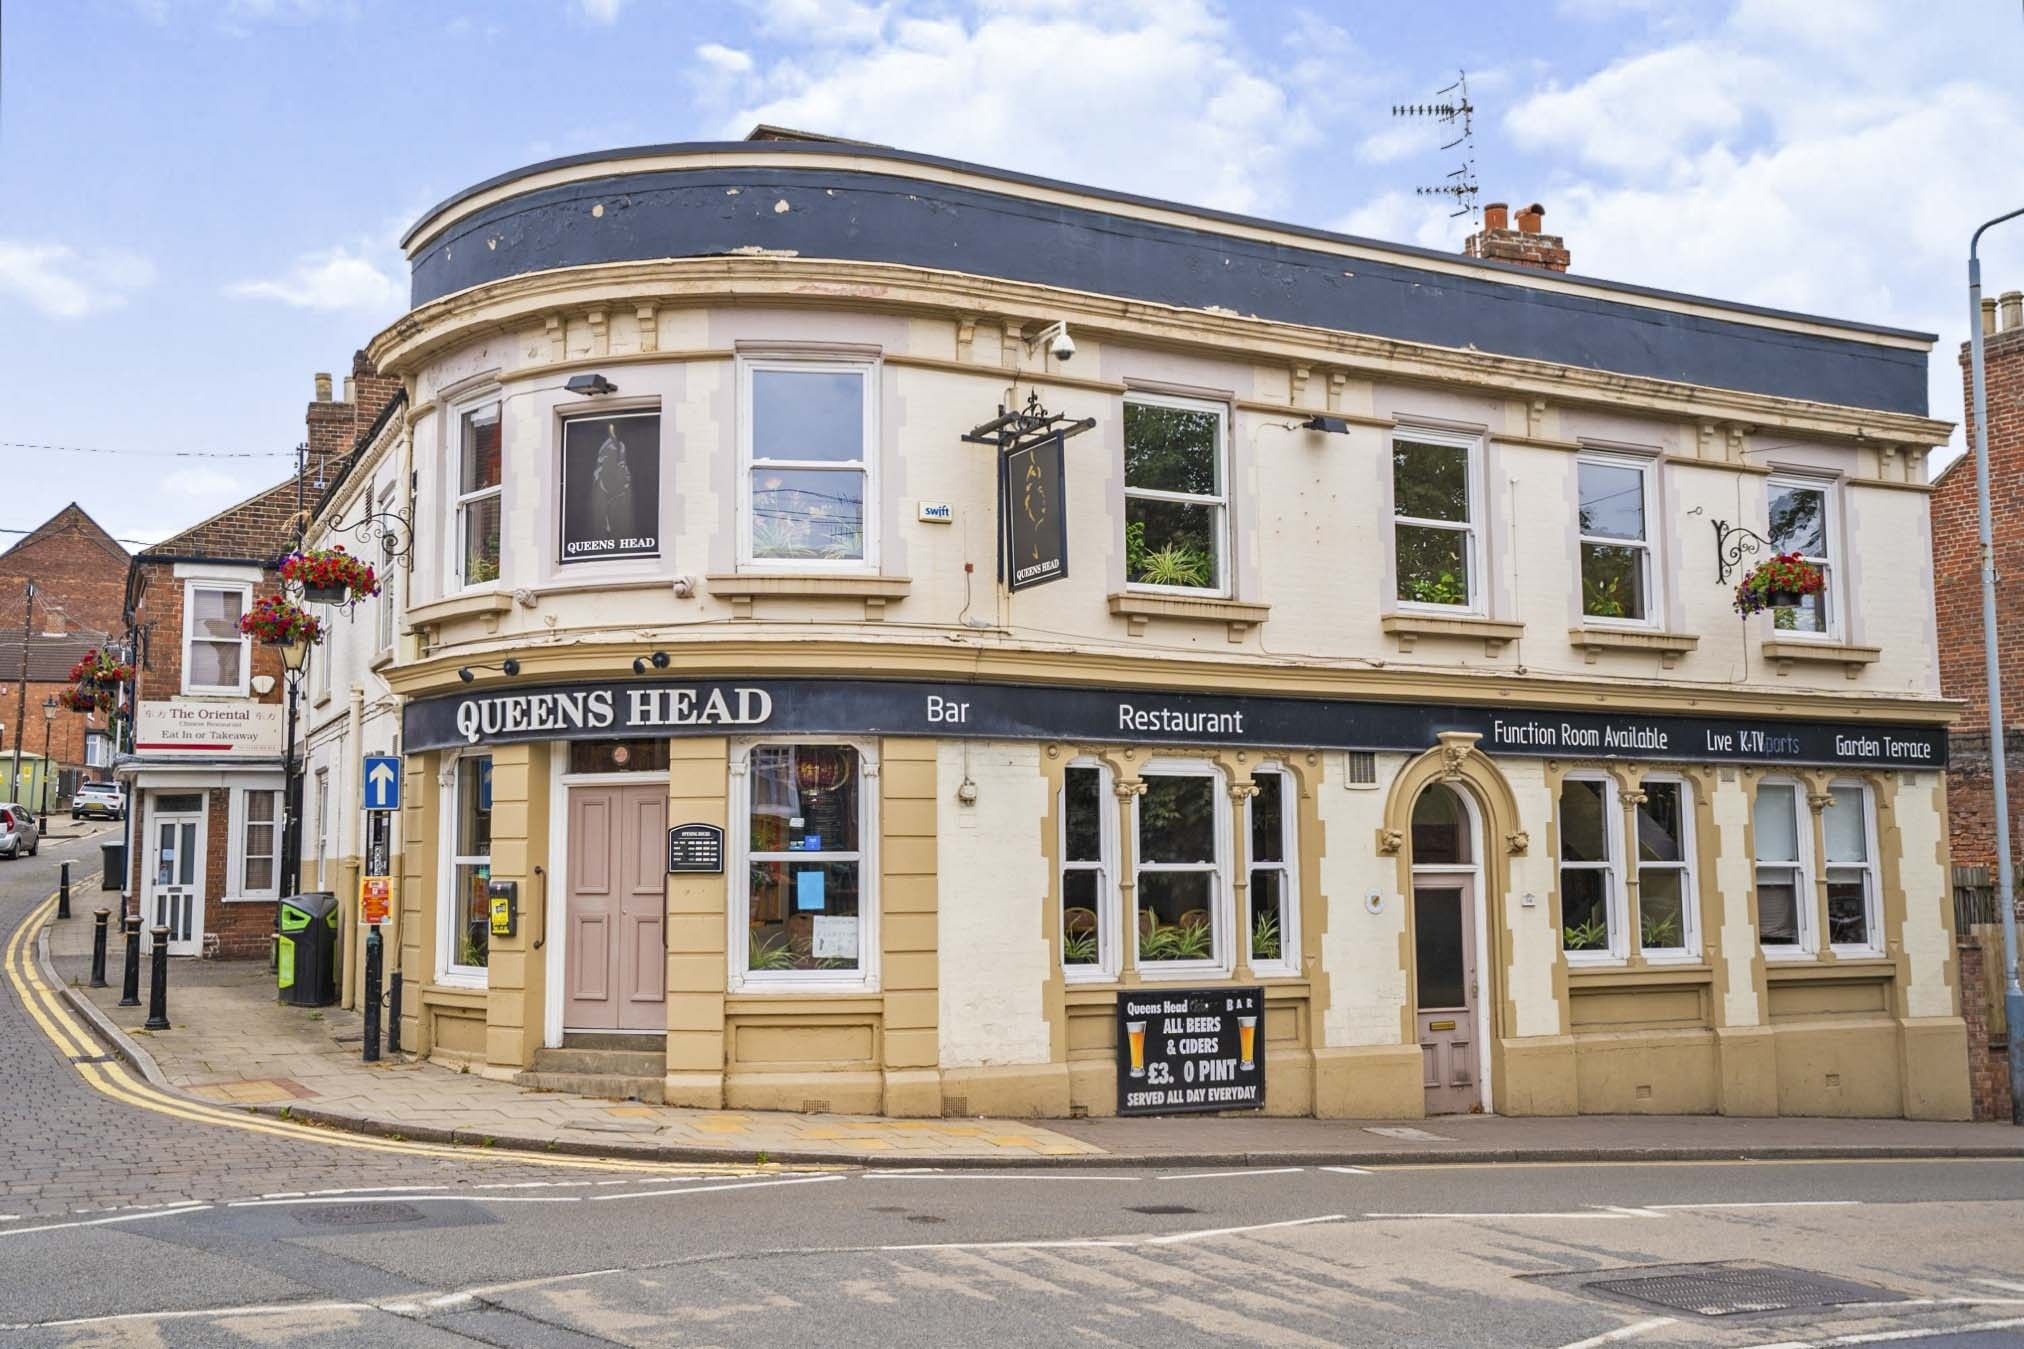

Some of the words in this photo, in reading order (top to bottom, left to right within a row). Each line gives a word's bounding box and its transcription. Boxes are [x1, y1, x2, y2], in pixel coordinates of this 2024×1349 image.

[925, 505, 949, 517] swift
[567, 539, 615, 554] QUEENS
[620, 537, 656, 549] HEAD
[1016, 563, 1042, 580] QUEENS
[1041, 559, 1060, 573] HEAD
[169, 708, 195, 720] The
[198, 709, 250, 721] Oriental
[456, 689, 615, 744] QUEENS
[626, 687, 772, 726] HEAD
[926, 695, 970, 724] Bar
[1118, 703, 1244, 734] Restaurant
[161, 730, 179, 740] Eat
[182, 730, 193, 740] In
[195, 732, 206, 740] or
[209, 731, 259, 742] Takeaway
[1494, 720, 1556, 745] Function
[1561, 723, 1600, 746] Room
[1604, 725, 1668, 749] Available
[1706, 728, 1733, 752] Live
[1836, 734, 1880, 757] Garden
[1883, 736, 1932, 758] Terrace
[1127, 1002, 1162, 1017] Queens
[1163, 999, 1188, 1014] Head
[1163, 1018, 1184, 1034] ALL
[1186, 1017, 1221, 1033] BEERS
[1166, 1039, 1177, 1055] &
[1179, 1038, 1219, 1054] CIDERS
[1198, 1058, 1238, 1082] PINT
[1127, 1091, 1165, 1107] SERVED
[1166, 1089, 1184, 1104] ALL
[1186, 1088, 1206, 1103] DAY
[1207, 1085, 1257, 1102] EVERYDAY
